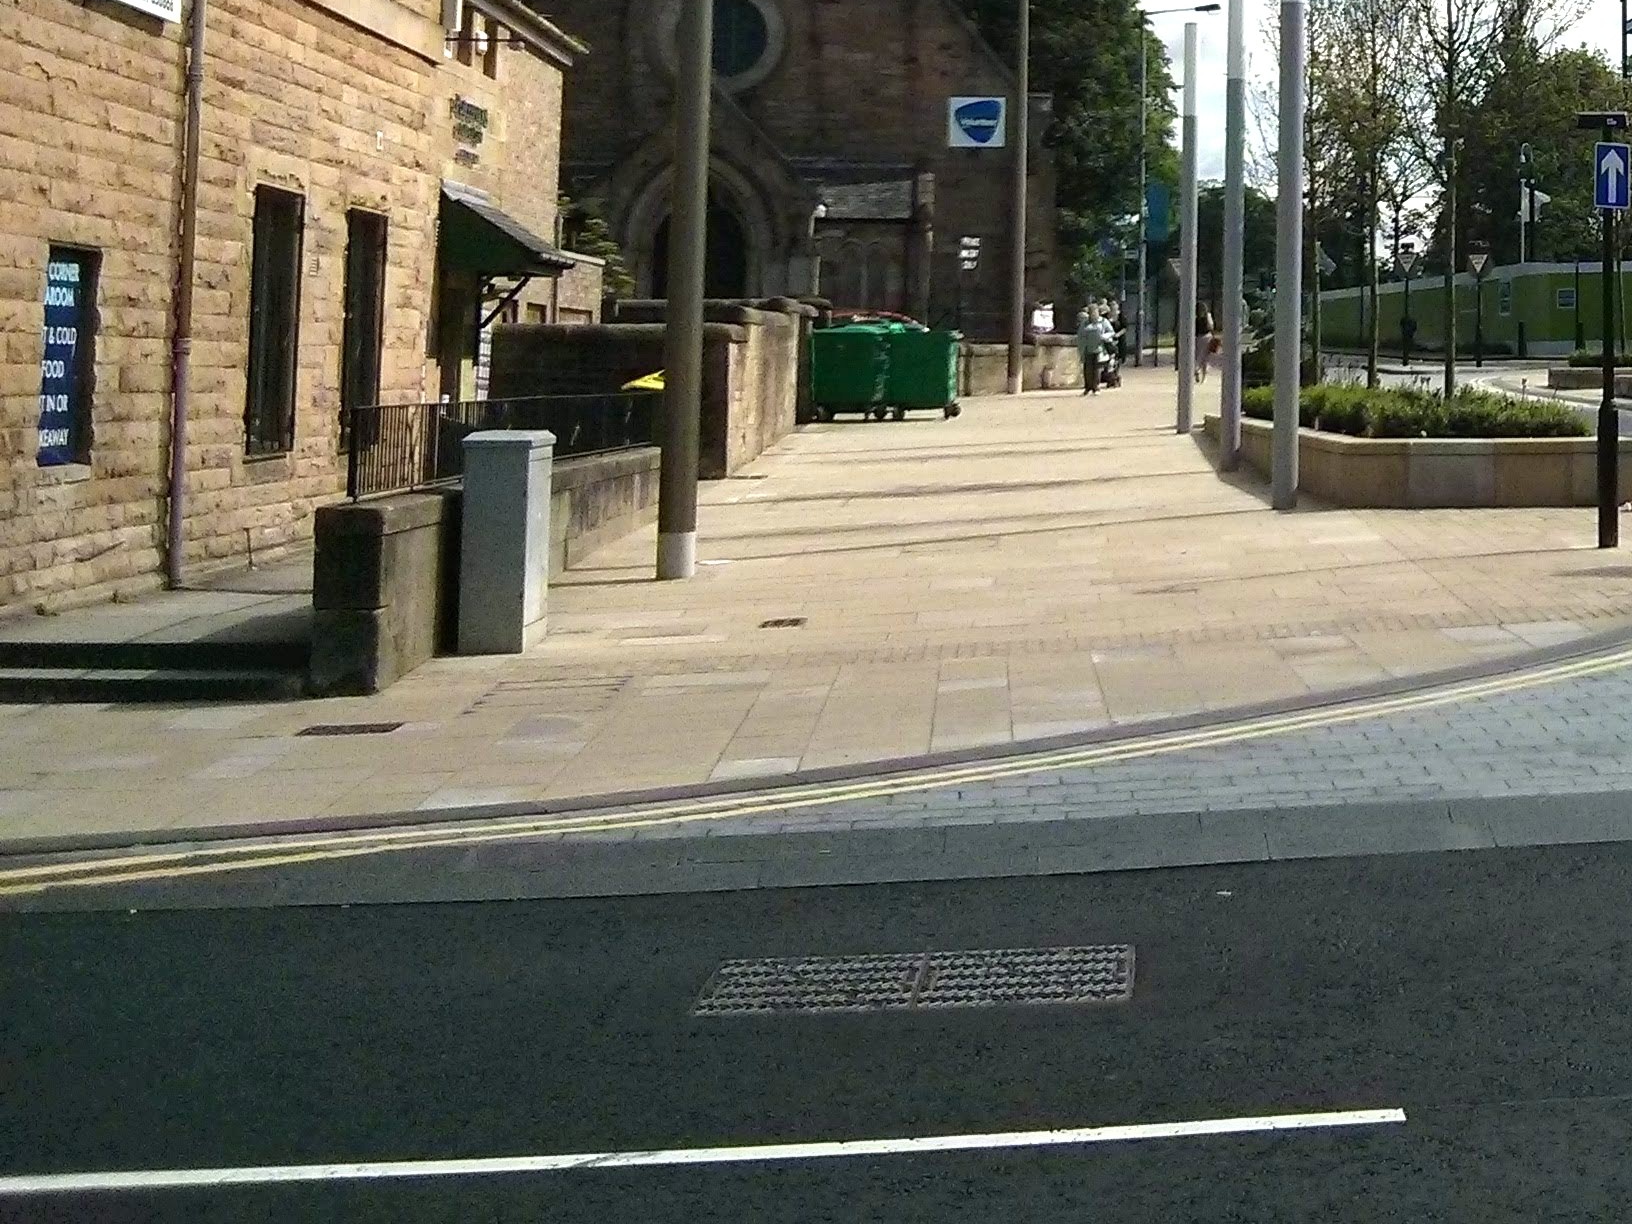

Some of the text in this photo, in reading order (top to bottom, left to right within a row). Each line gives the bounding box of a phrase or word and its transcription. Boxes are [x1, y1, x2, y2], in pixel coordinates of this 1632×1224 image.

[48, 262, 80, 282] CORNER
[56, 327, 78, 344] COLD
[41, 359, 65, 378] FOOD
[57, 394, 69, 412] OR
